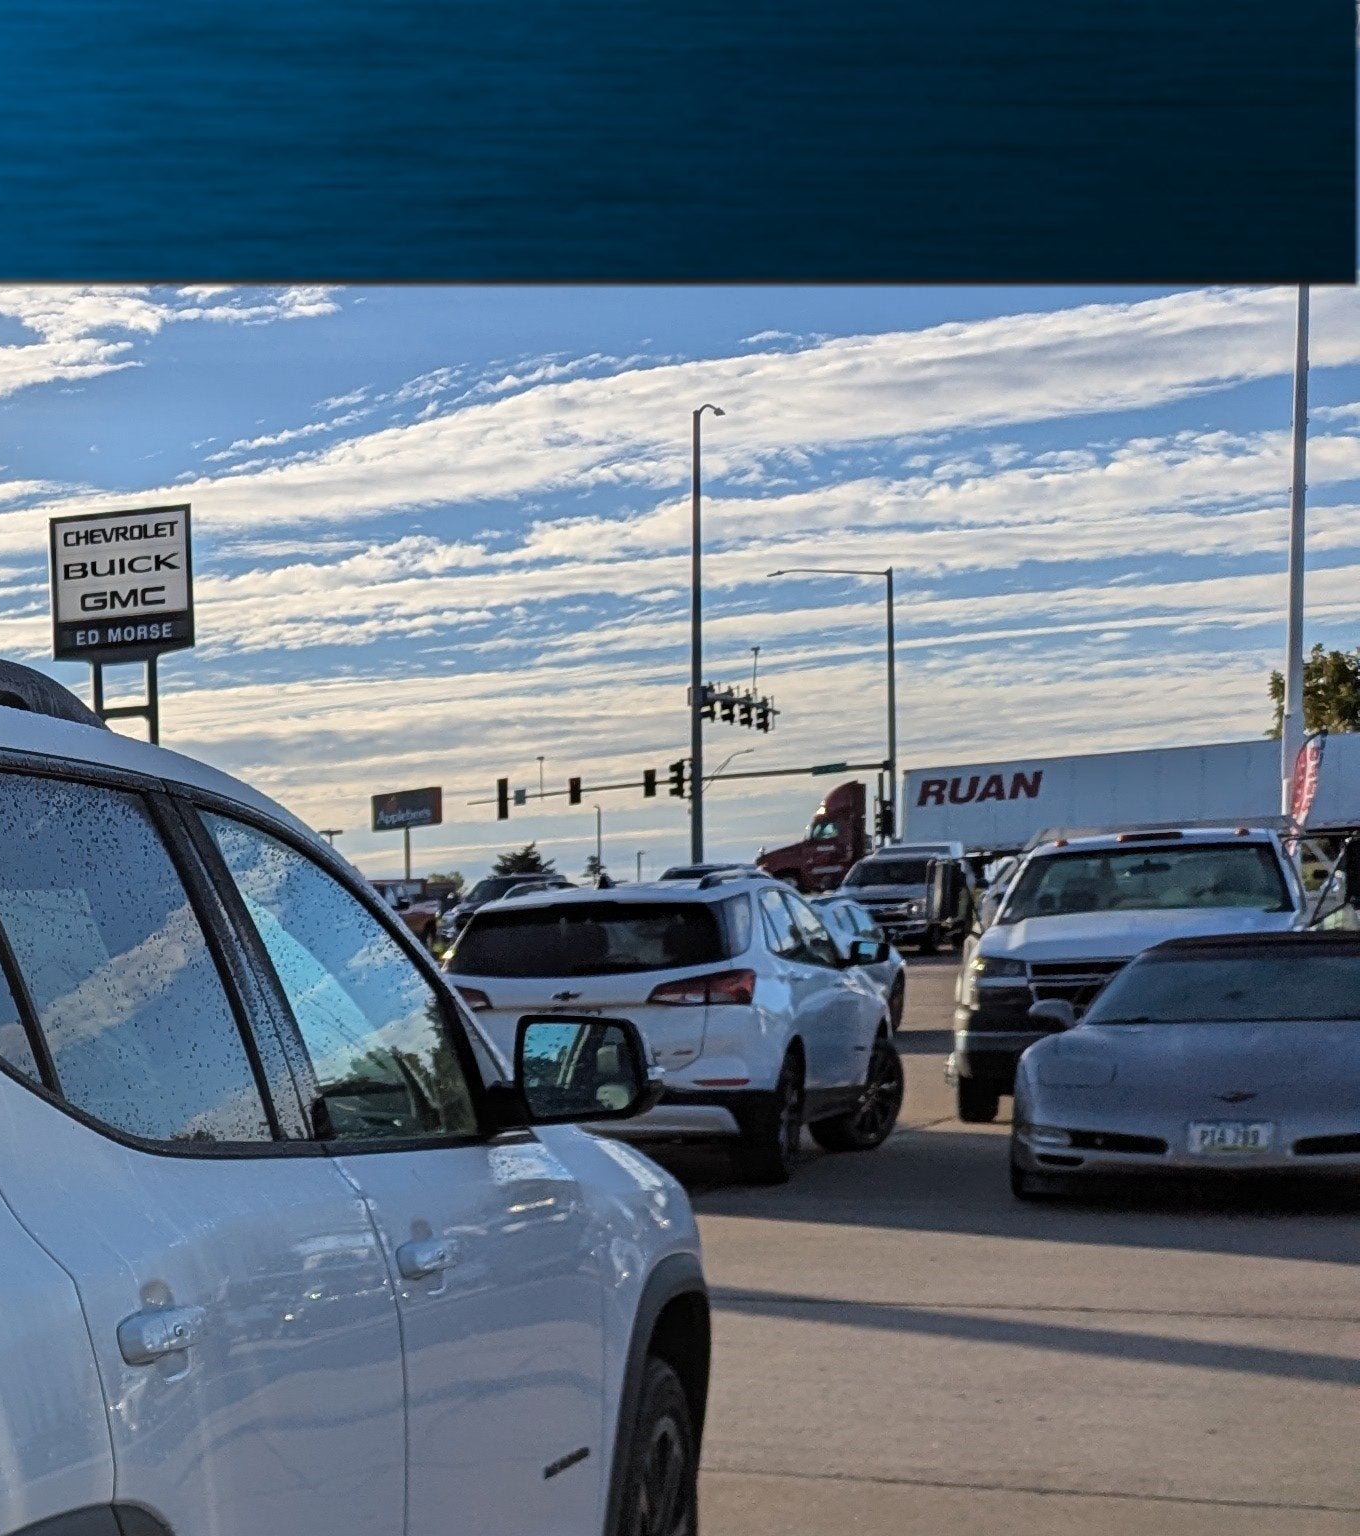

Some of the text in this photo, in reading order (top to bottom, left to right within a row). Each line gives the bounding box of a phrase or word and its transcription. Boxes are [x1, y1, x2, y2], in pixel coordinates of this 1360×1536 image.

[63, 520, 178, 547] CHEVROLET
[63, 552, 180, 580] BUICK
[80, 586, 165, 613] GMC
[76, 623, 173, 646] ED MORSE
[916, 769, 1044, 806] RUAN
